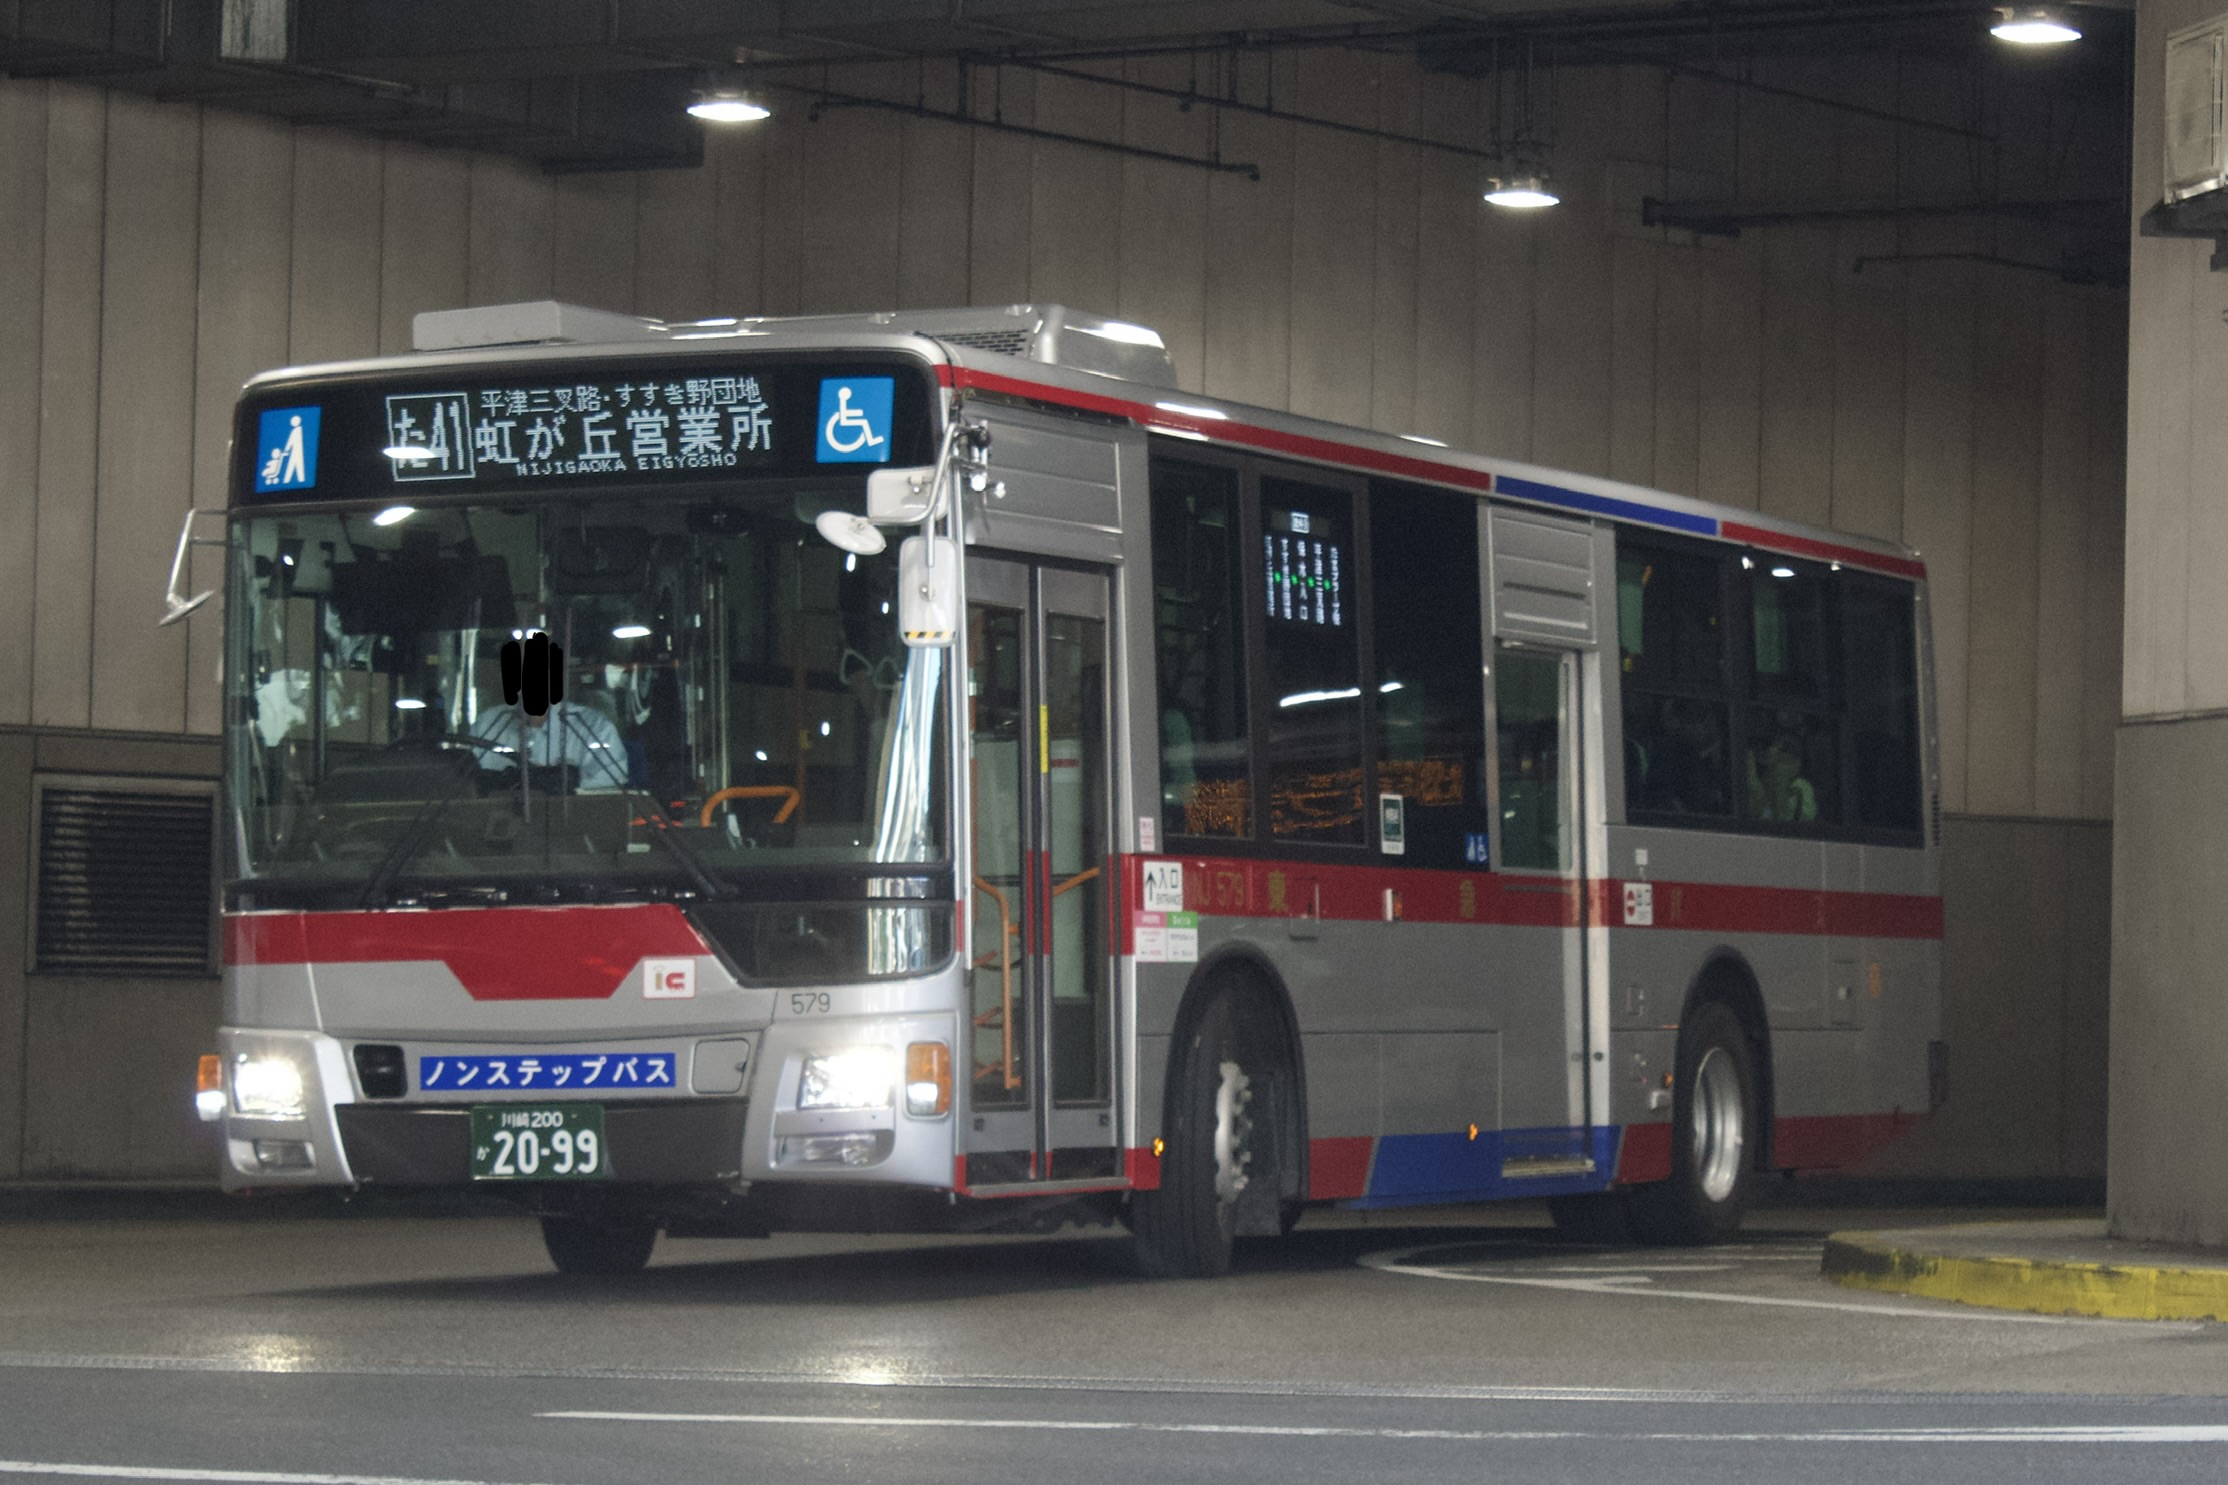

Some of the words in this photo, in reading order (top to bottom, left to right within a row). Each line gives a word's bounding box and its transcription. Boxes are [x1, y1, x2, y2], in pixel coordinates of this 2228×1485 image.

[475, 403, 773, 464] 虹が丘営業所
[516, 460, 627, 476] NIJIGAOKA
[638, 454, 738, 471] EIGYOSHO
[1158, 866, 1180, 889] 入口
[791, 992, 832, 1016] 579
[425, 1057, 671, 1088] ノンステップバス
[531, 1111, 564, 1128] 200
[493, 1129, 599, 1175] 20-99
